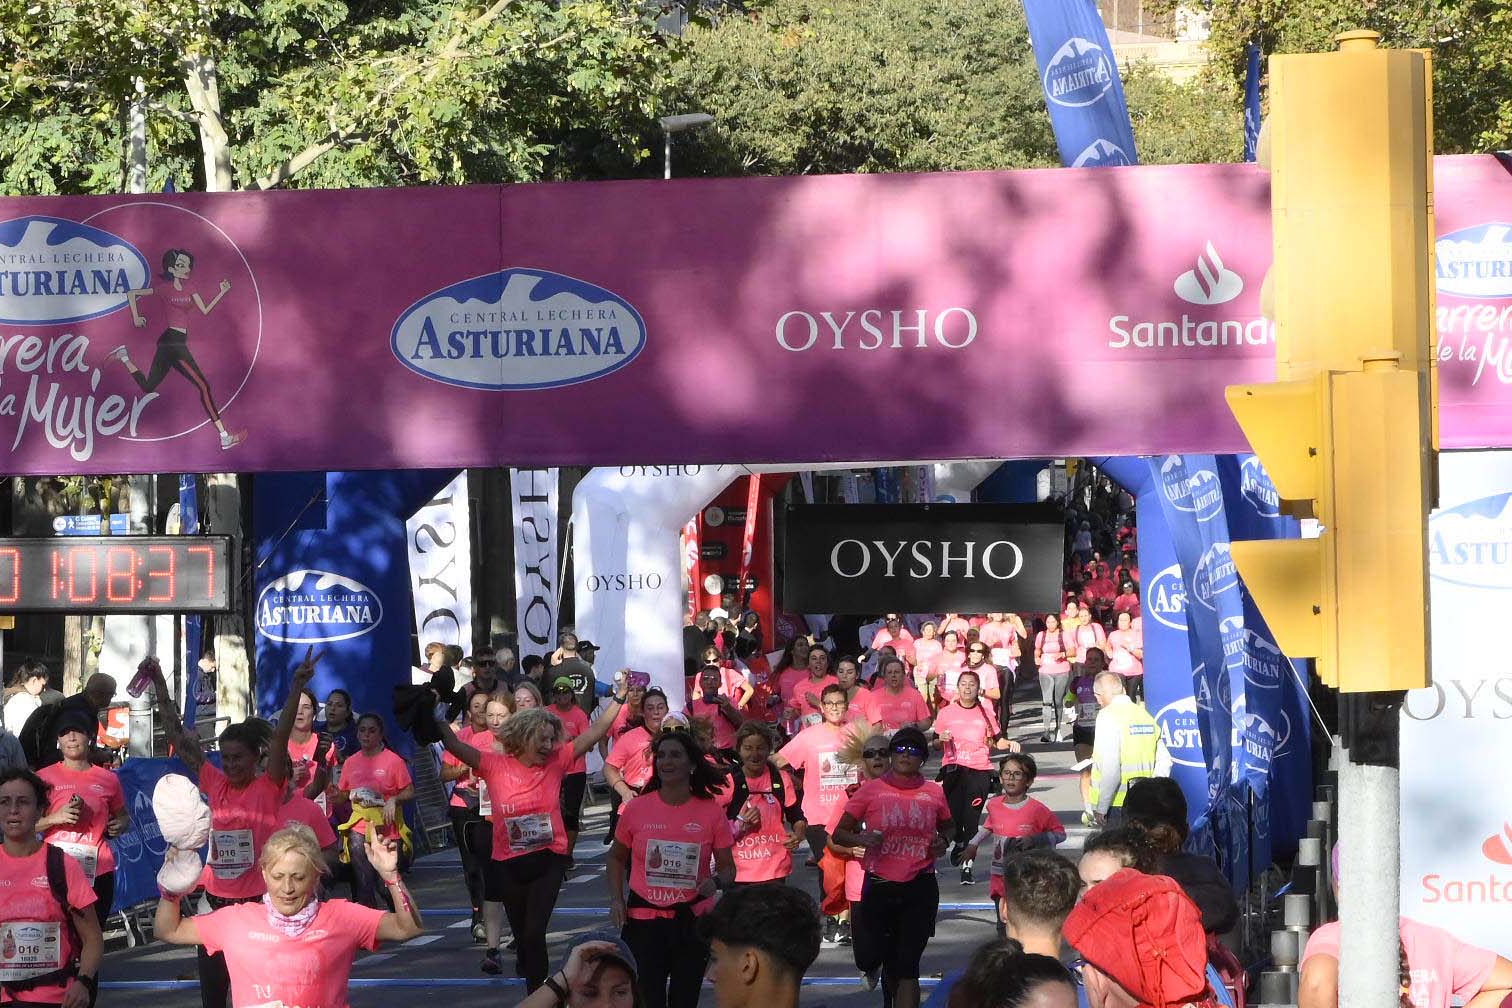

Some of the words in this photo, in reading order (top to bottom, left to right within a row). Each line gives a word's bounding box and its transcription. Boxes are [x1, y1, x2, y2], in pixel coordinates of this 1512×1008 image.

[52, 251, 126, 264] LECHERA
[450, 310, 529, 325] CENTRAL
[536, 308, 618, 322] LECHERA
[411, 315, 626, 360] ASTURIANA
[774, 307, 978, 352] OYSHO
[1109, 314, 1276, 349] Santand
[11, 368, 161, 461] Mujer
[829, 538, 1024, 581] OYSHO
[586, 572, 662, 593] OYSHO
[273, 594, 316, 604] CENTRAL
[319, 593, 369, 603] LECHERA
[261, 597, 373, 627] ASTURIANA
[219, 849, 236, 857] 016
[737, 848, 772, 860] SUMA
[662, 858, 681, 868] 016
[648, 888, 686, 901] SUMA
[18, 945, 40, 954] 016
